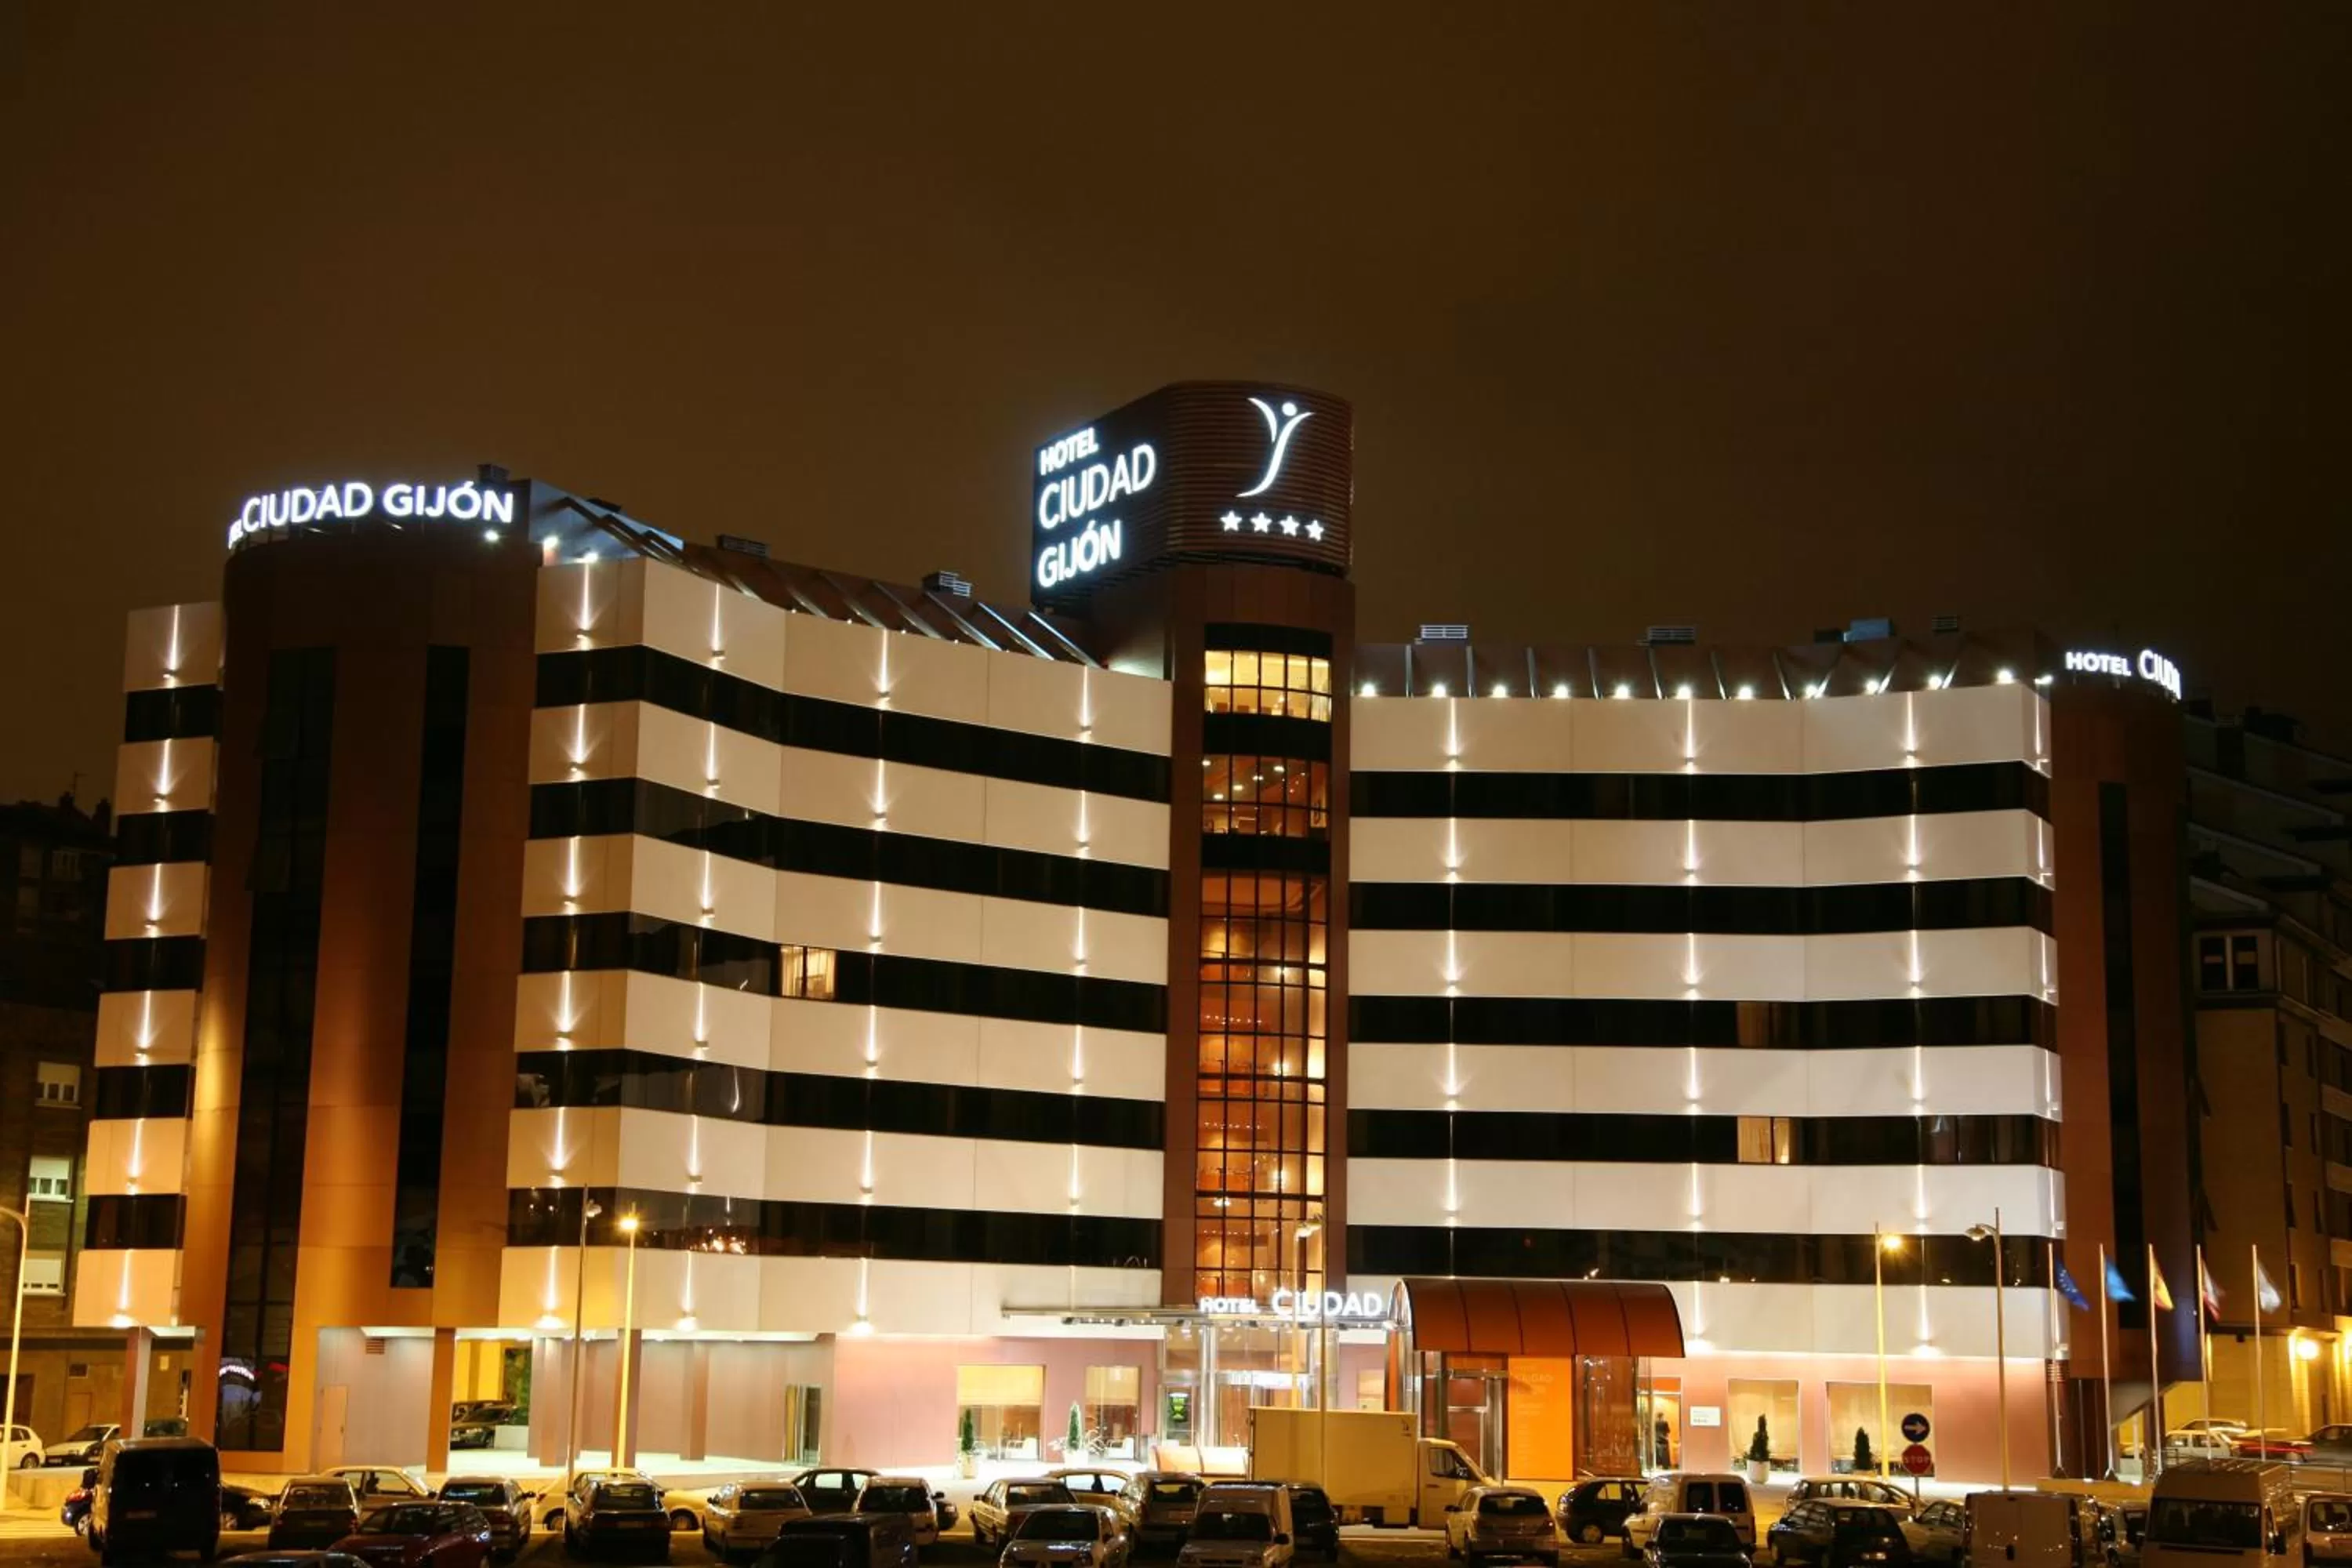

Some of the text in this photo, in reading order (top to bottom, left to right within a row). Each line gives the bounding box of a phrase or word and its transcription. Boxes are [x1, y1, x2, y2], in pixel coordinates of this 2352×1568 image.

[1040, 426, 1099, 476] HOTEL
[242, 482, 373, 532] CIUDAD
[383, 481, 514, 524] GIJÓN
[1039, 443, 1156, 530] CIUDAD
[1037, 519, 1122, 588] GIJÓN
[2066, 652, 2132, 677] HOTEL
[1200, 1289, 1383, 1317] HOTEL CIUDAD
[1903, 1454, 1930, 1465] STOP
